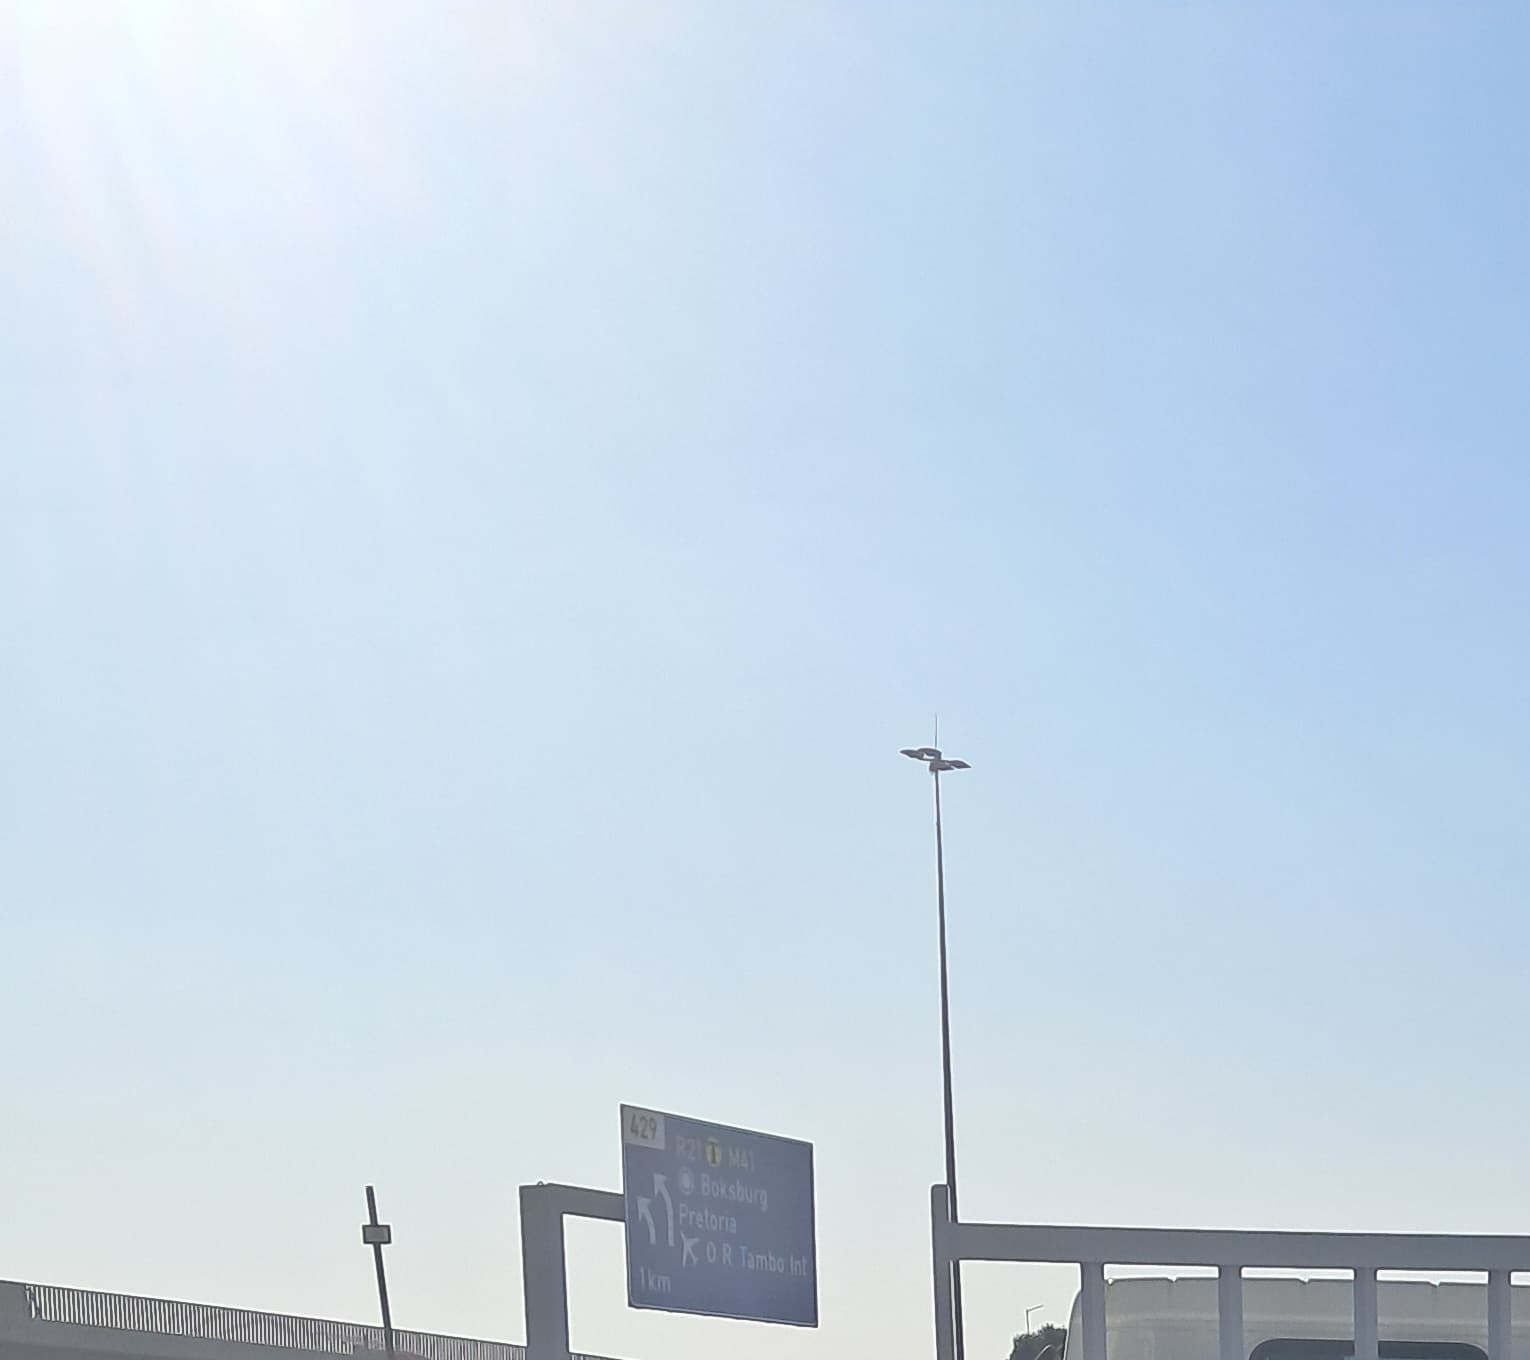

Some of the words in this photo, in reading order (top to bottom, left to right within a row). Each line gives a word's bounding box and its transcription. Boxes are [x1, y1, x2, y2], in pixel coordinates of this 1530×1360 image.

[629, 1112, 657, 1140] 429
[701, 1173, 768, 1212] Boksburg
[679, 1203, 737, 1233] Pretoria
[722, 1243, 733, 1265] R
[740, 1245, 785, 1273] Tambo
[789, 1255, 807, 1276] Int
